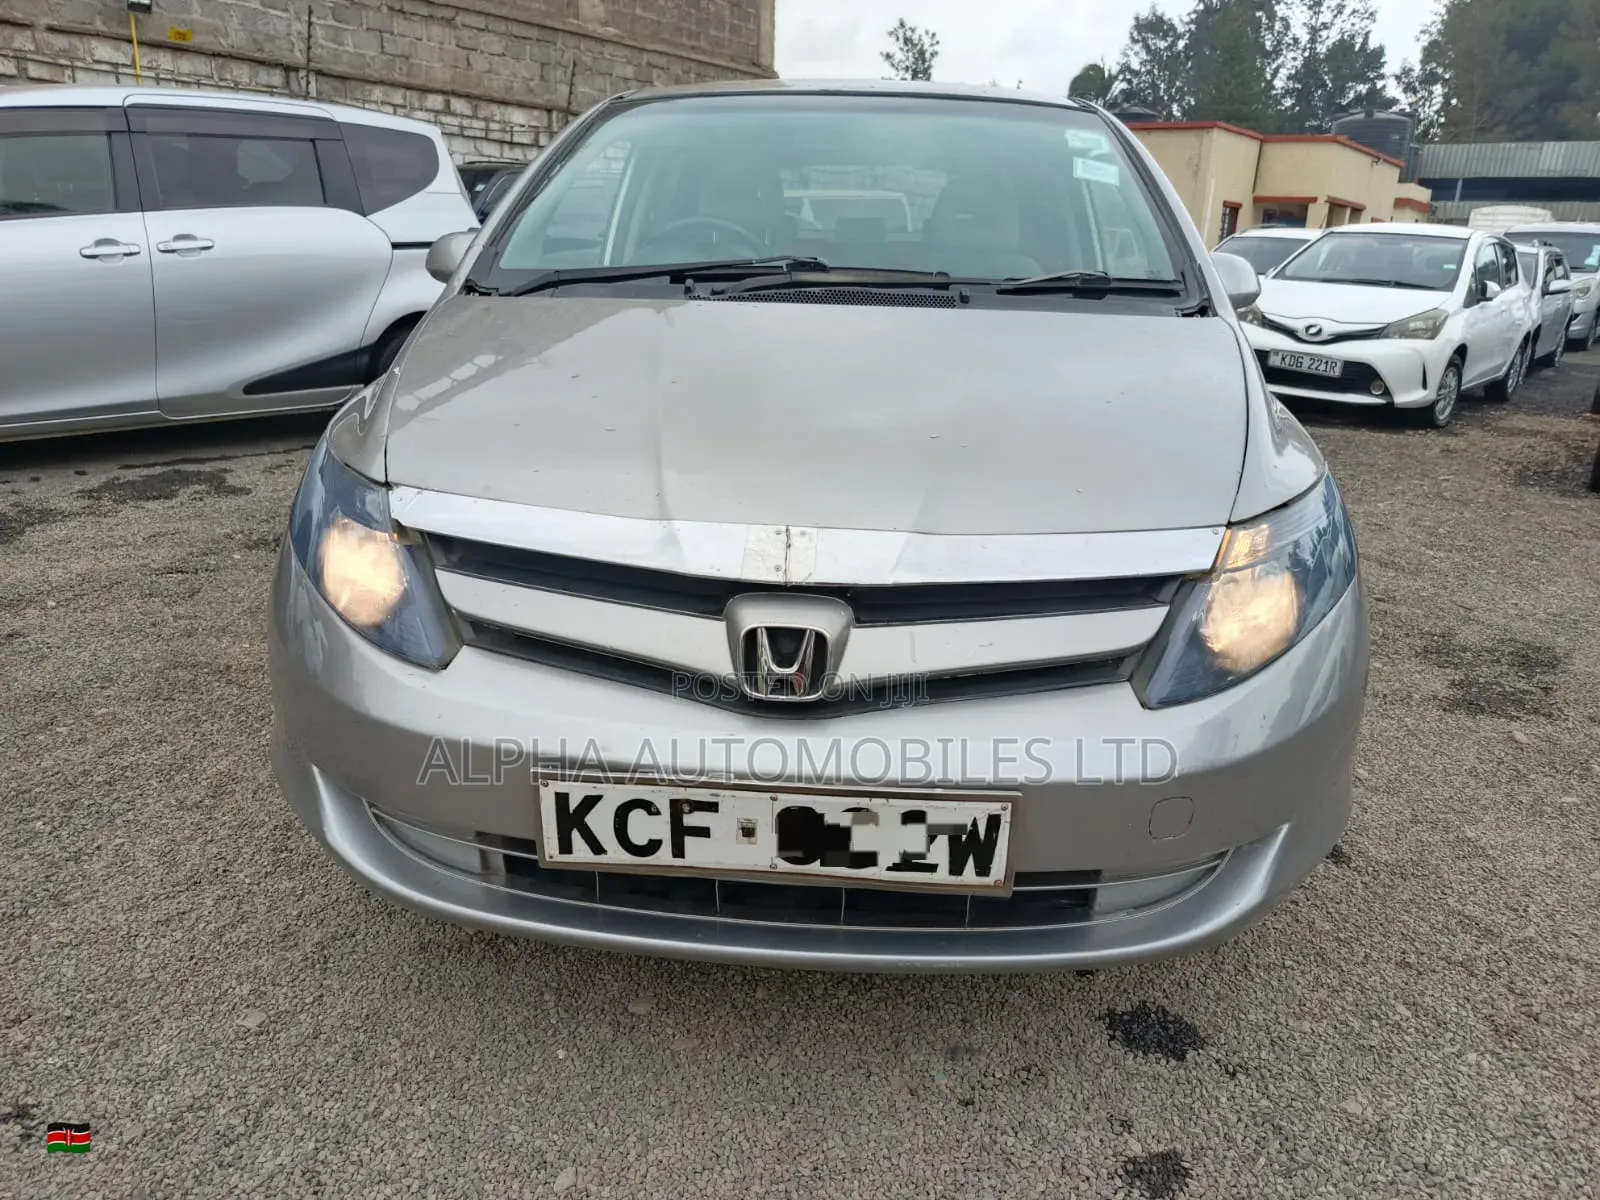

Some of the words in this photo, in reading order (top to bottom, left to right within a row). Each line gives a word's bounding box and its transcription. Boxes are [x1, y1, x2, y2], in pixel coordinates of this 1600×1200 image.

[1280, 353, 1303, 369] KDG
[1307, 358, 1338, 375] 221R
[553, 791, 720, 859] KCF
